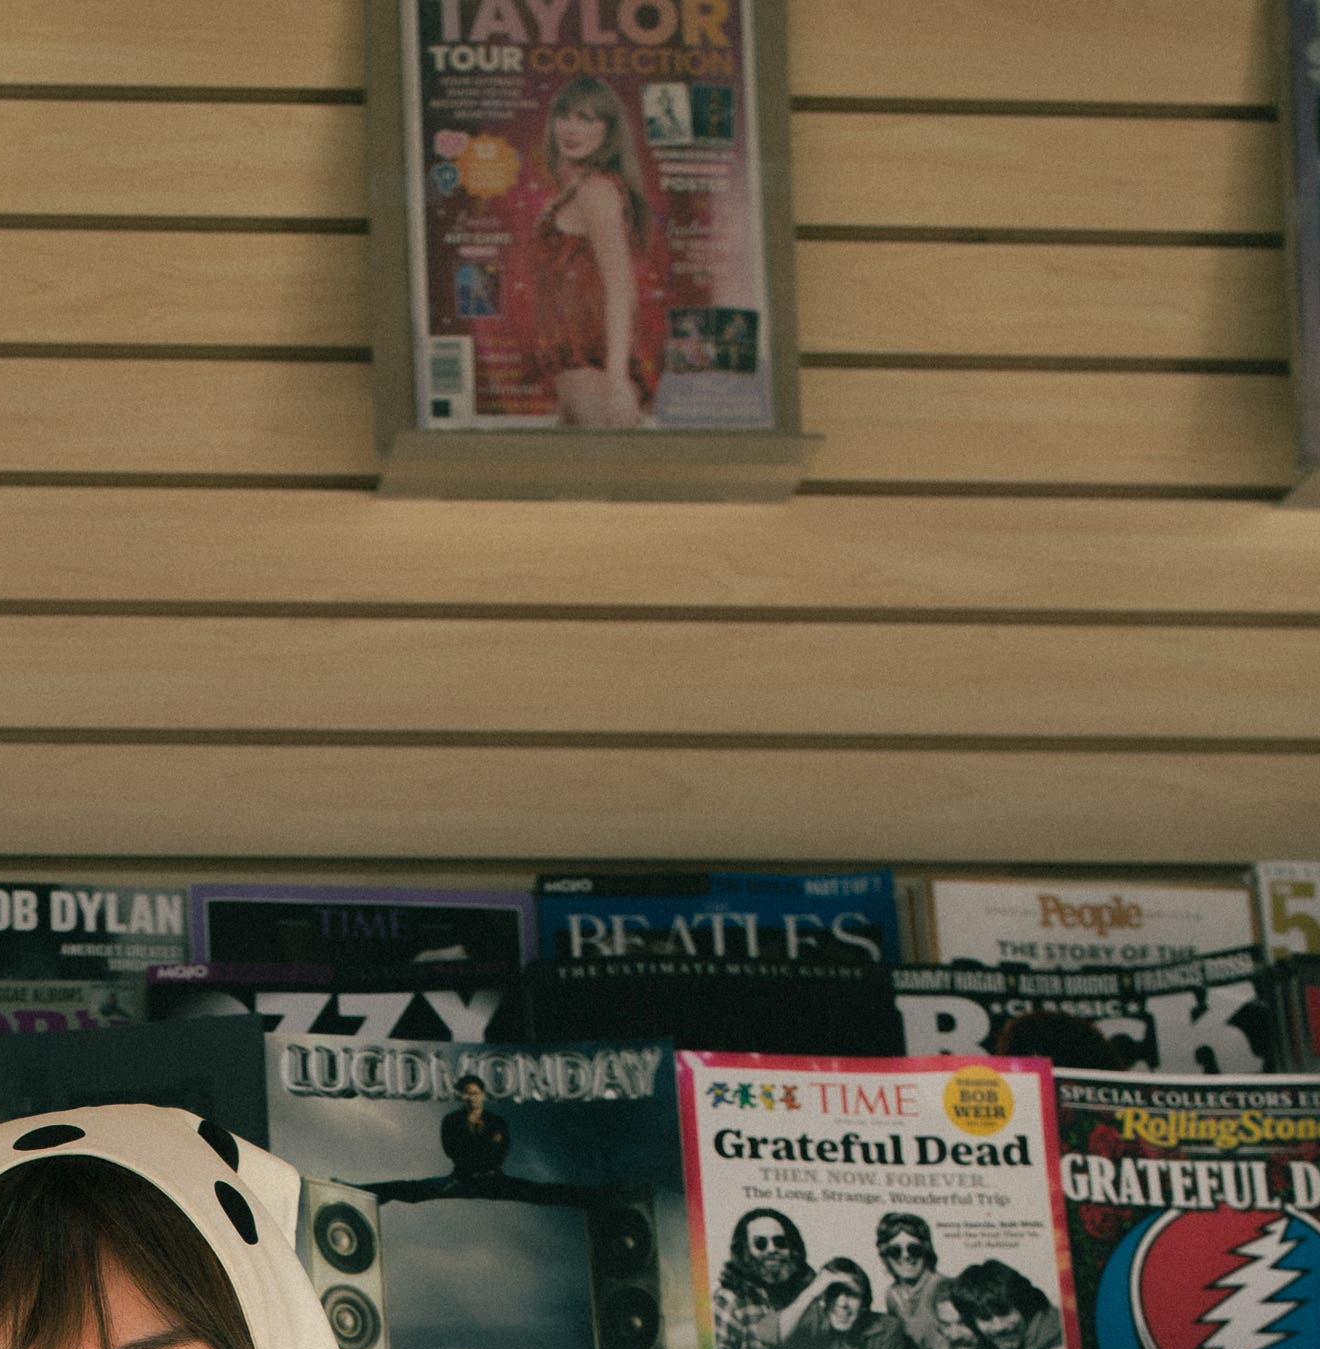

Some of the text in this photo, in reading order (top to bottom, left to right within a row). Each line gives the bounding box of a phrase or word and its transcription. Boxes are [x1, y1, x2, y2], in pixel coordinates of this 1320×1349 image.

[428, 46, 733, 77] TOUR COLLECTION
[51, 890, 184, 935] DYLAN
[1037, 892, 1144, 936] People
[567, 911, 884, 964] BEATLES
[997, 939, 1115, 961] THE STORY
[156, 963, 210, 980] MOJO
[809, 1082, 921, 1118] TIME
[1060, 1083, 1291, 1108] SPECIAL COLLECTORS
[952, 1104, 1007, 1120] WEIR
[713, 1128, 1032, 1167] Grateful Dead
[884, 1172, 985, 1188] FOREVER
[1060, 1152, 1282, 1210] GRATEFUL
[742, 1186, 974, 1206] The Wonderful
